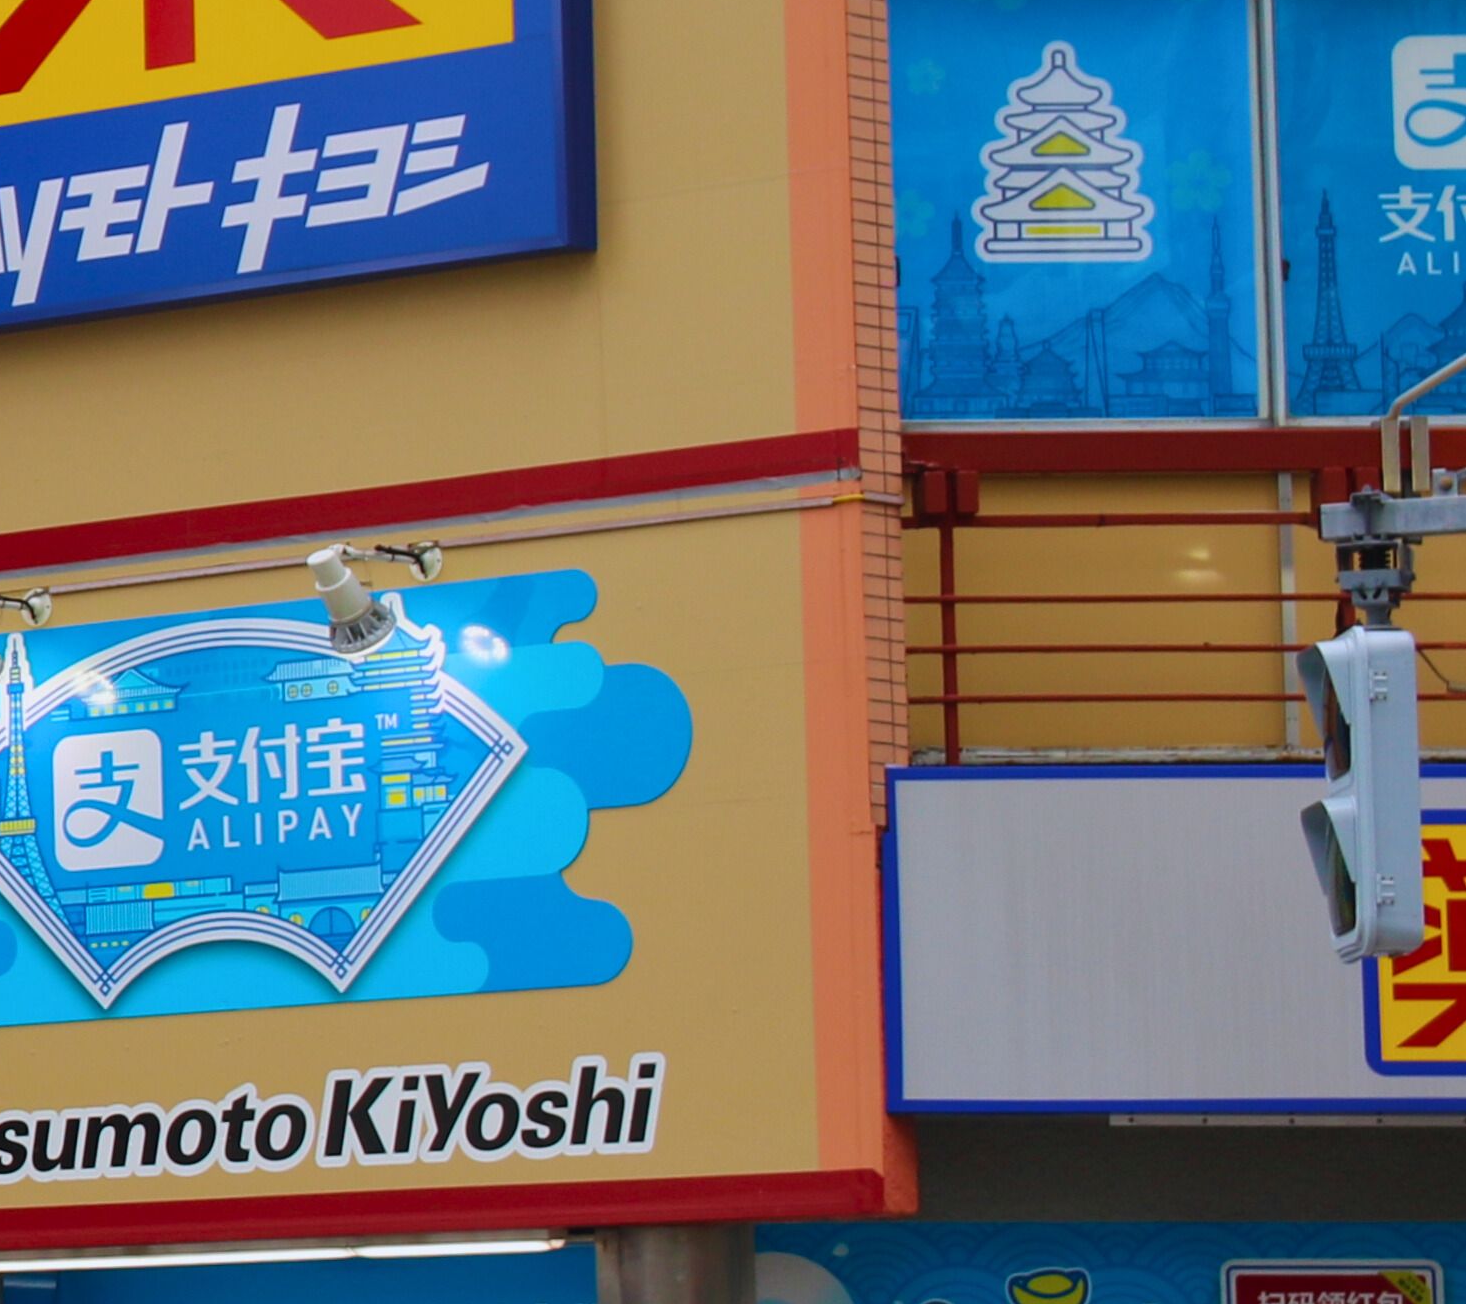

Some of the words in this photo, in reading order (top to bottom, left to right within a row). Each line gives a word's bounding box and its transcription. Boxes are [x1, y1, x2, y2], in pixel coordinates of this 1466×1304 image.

[178, 719, 368, 812] 支付宝
[187, 803, 365, 851] ALIPAY
[323, 1061, 658, 1159] KiYoshi
